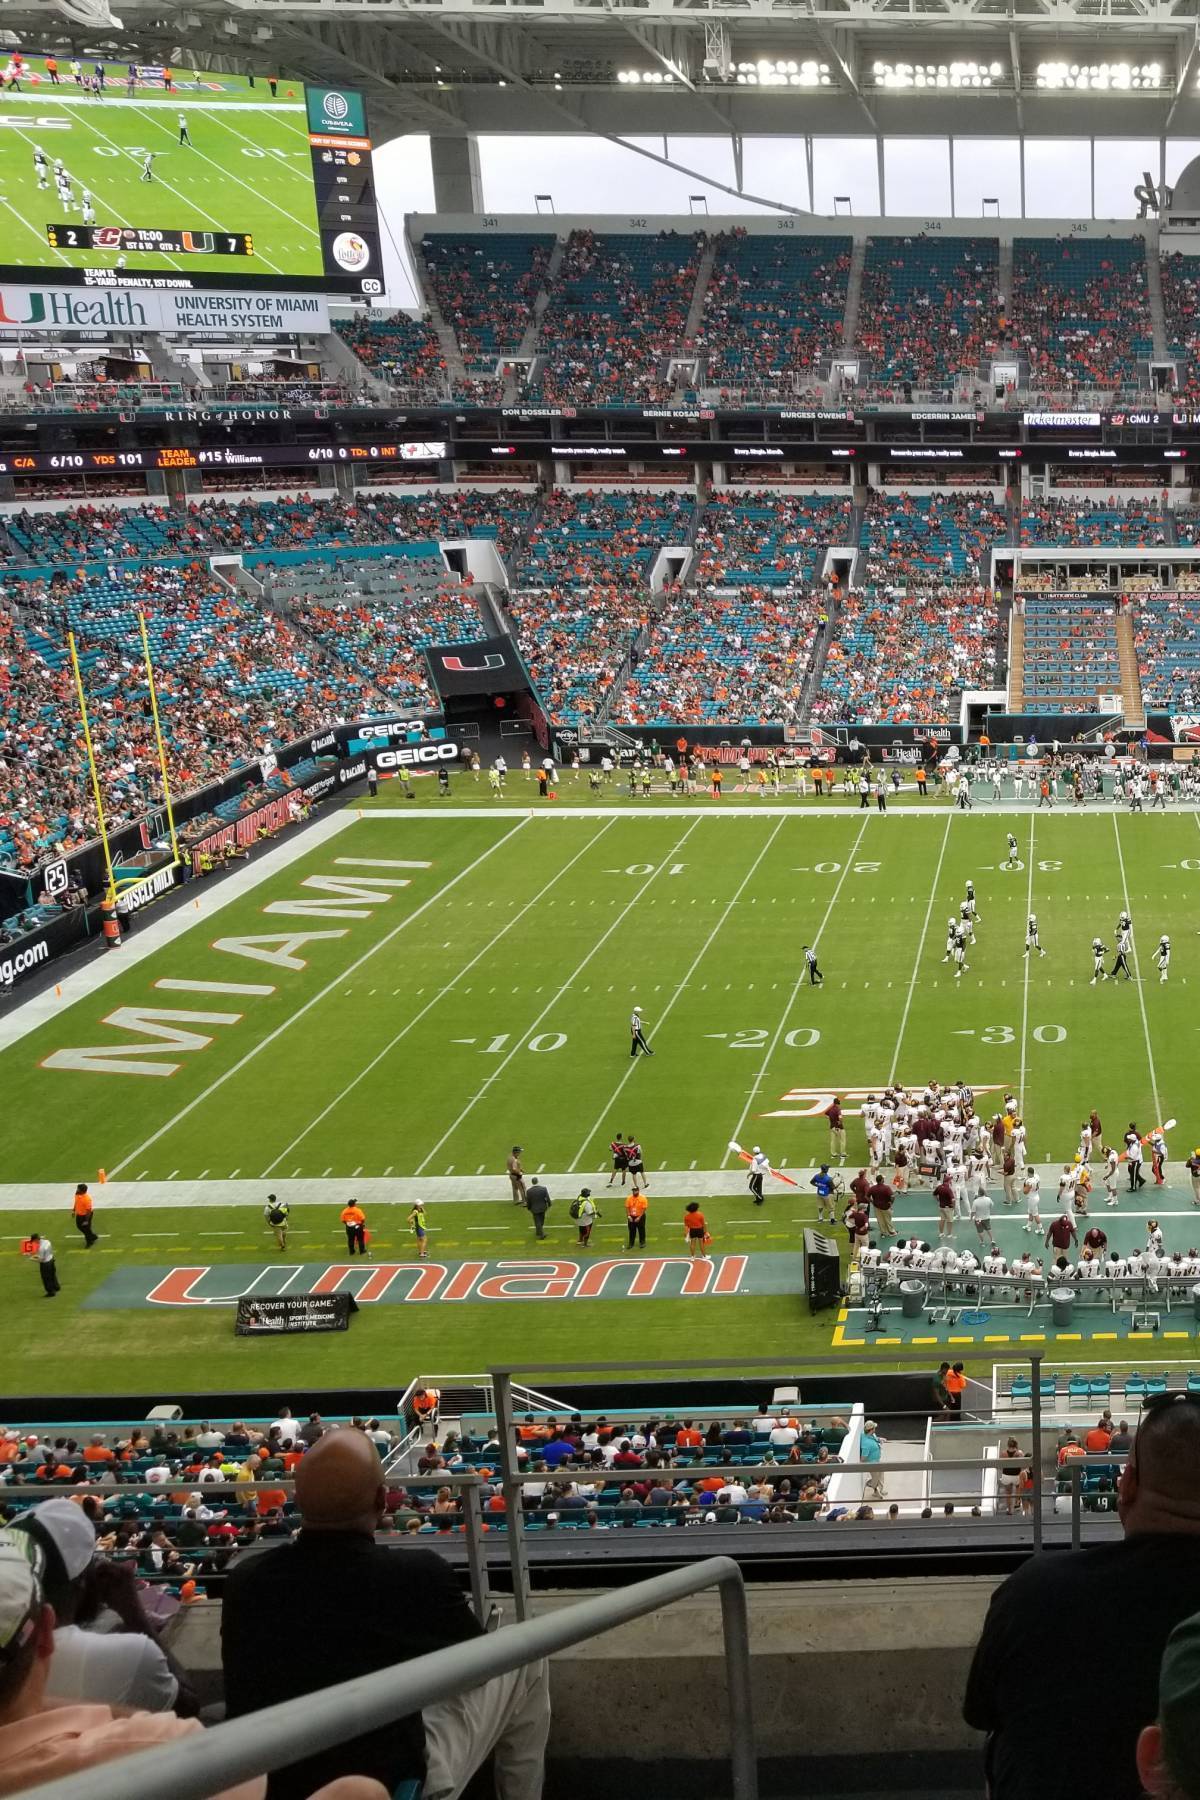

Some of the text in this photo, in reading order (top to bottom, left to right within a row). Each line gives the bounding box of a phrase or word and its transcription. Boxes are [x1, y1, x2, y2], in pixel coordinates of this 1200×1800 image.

[483, 218, 498, 227] 341
[630, 219, 647, 228] 342
[778, 220, 794, 228] 343
[925, 222, 941, 230] 344
[1072, 224, 1088, 232] 345
[66, 231, 78, 245] 2
[138, 231, 164, 241] 11:00
[227, 238, 236, 252] 7
[363, 280, 379, 292] CC
[174, 296, 318, 312] UNIVERSITY OF MIAMI
[177, 313, 282, 328] HEALTH SYSTEM
[166, 411, 292, 421] RING HONOR
[1154, 416, 1159, 424] 2
[160, 449, 190, 458] TEAM
[308, 448, 332, 459] 6/10
[338, 448, 348, 458] 0
[370, 446, 378, 457] 0
[381, 446, 396, 456] INT
[50, 455, 84, 467] 6/10
[94, 456, 116, 464] YDS
[119, 454, 142, 465] 101
[158, 457, 196, 466] LEADER
[358, 720, 424, 739] GEICO
[376, 743, 458, 768] GEICO
[49, 866, 65, 892] 25
[154, 868, 174, 894] MILK
[38, 856, 434, 1077] MIAMI
[729, 1029, 820, 1049] 20
[981, 1024, 1068, 1044] 30
[477, 1032, 568, 1052] 10
[250, 1302, 284, 1310] RECOVER
[288, 1301, 307, 1309] YOUR
